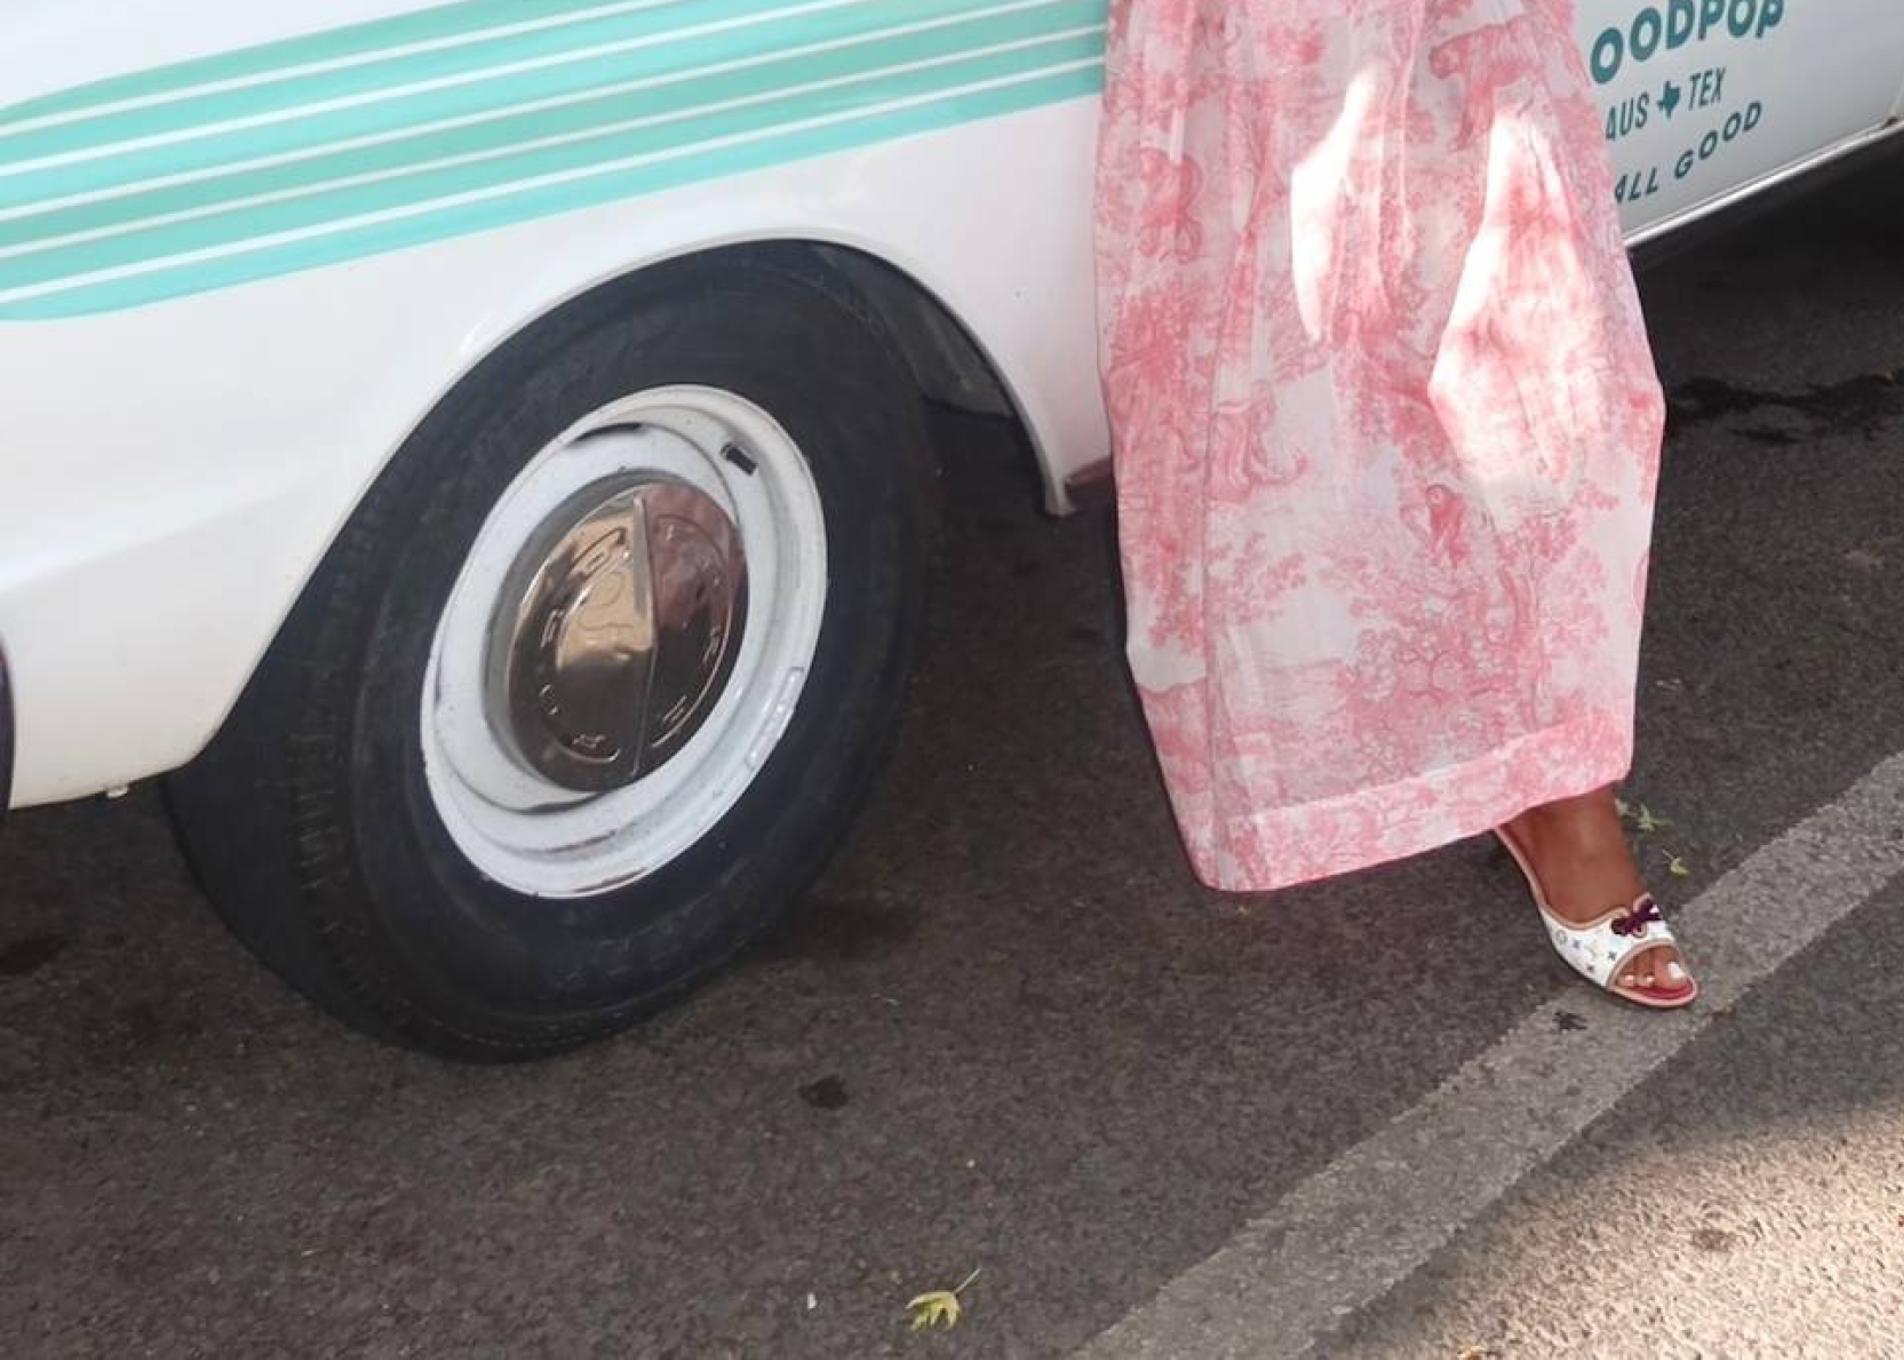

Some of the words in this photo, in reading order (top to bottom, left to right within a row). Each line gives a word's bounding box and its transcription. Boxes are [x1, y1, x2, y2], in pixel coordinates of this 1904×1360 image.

[1605, 92, 1649, 141] AUS
[1688, 67, 1725, 111] TEX
[1614, 166, 1658, 204] ALL
[1674, 102, 1762, 180] GOOD
